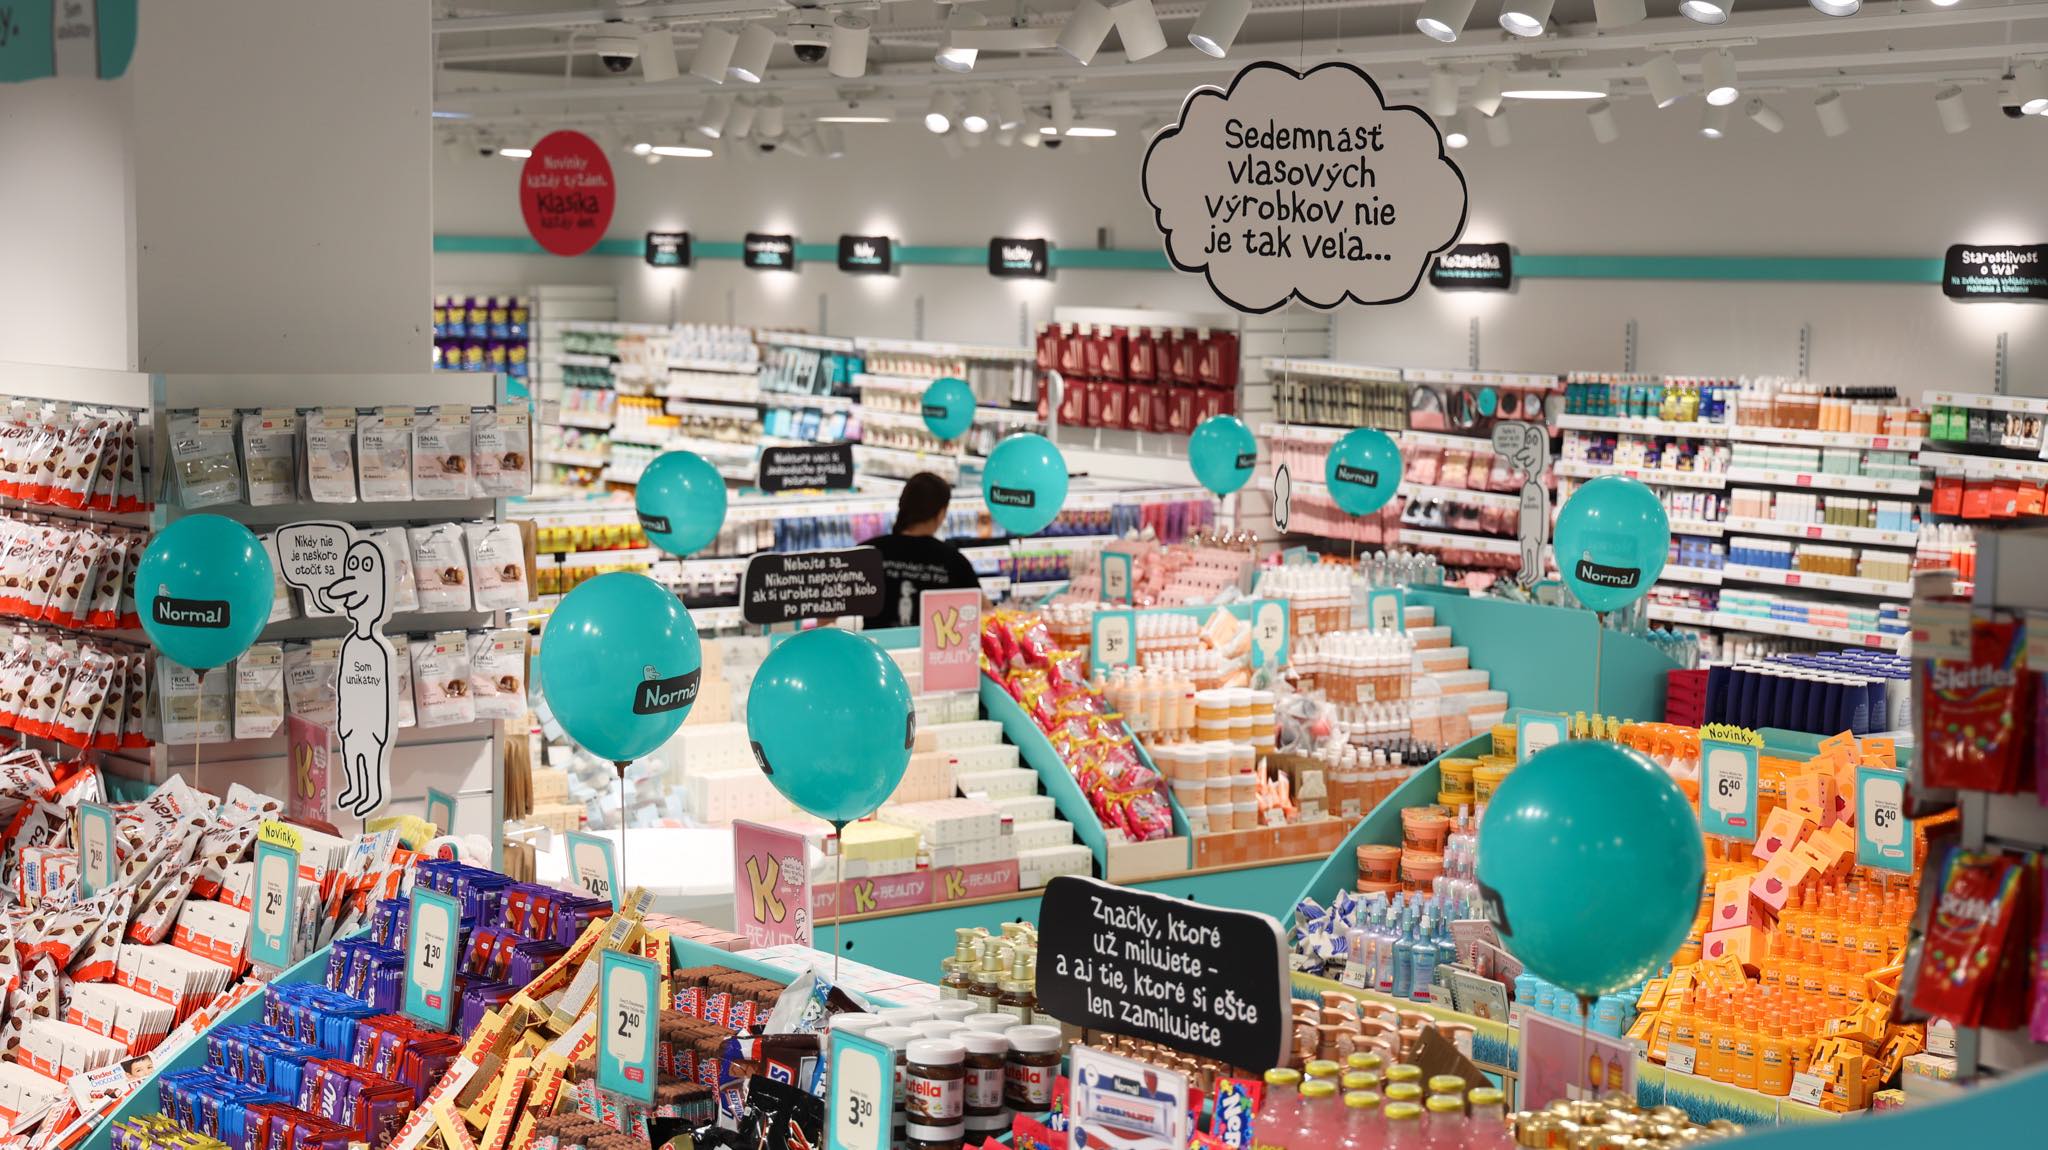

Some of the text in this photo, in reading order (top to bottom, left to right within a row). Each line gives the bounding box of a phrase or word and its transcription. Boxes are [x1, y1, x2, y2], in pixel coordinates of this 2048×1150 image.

[1225, 118, 1384, 152] Sedemnásť
[1228, 154, 1376, 191] vlasových
[537, 192, 599, 214] Klasika
[1205, 189, 1396, 225] výrobkov nie
[1204, 226, 1392, 261] je tak veľa...
[1980, 265, 1988, 275] o
[1339, 467, 1375, 485] Normal
[992, 489, 1031, 505] Normal
[295, 535, 333, 549] Nikdy nie
[291, 549, 338, 561] je neskoro
[783, 558, 826, 571] Nebojte
[324, 565, 336, 575] sa
[765, 573, 805, 588] Nikomu
[1582, 566, 1635, 585] Normal
[752, 588, 767, 603] ak
[768, 588, 778, 601] si
[854, 581, 878, 596] kolo
[159, 601, 222, 623] Normal
[784, 597, 846, 617] po predajni
[932, 606, 962, 650] K
[354, 661, 372, 672] Som
[645, 676, 699, 708] Normal
[1709, 728, 1753, 746] Novinky
[295, 742, 316, 800] K
[265, 825, 297, 848] Novinky
[745, 852, 787, 925] K
[1090, 896, 1221, 948] Značky, ktoré
[1093, 931, 1118, 957] už
[1125, 938, 1202, 977] milujete
[1056, 953, 1258, 1025] a aj tie, ktoré si ešte
[1087, 988, 1222, 1047] len zamilujete
